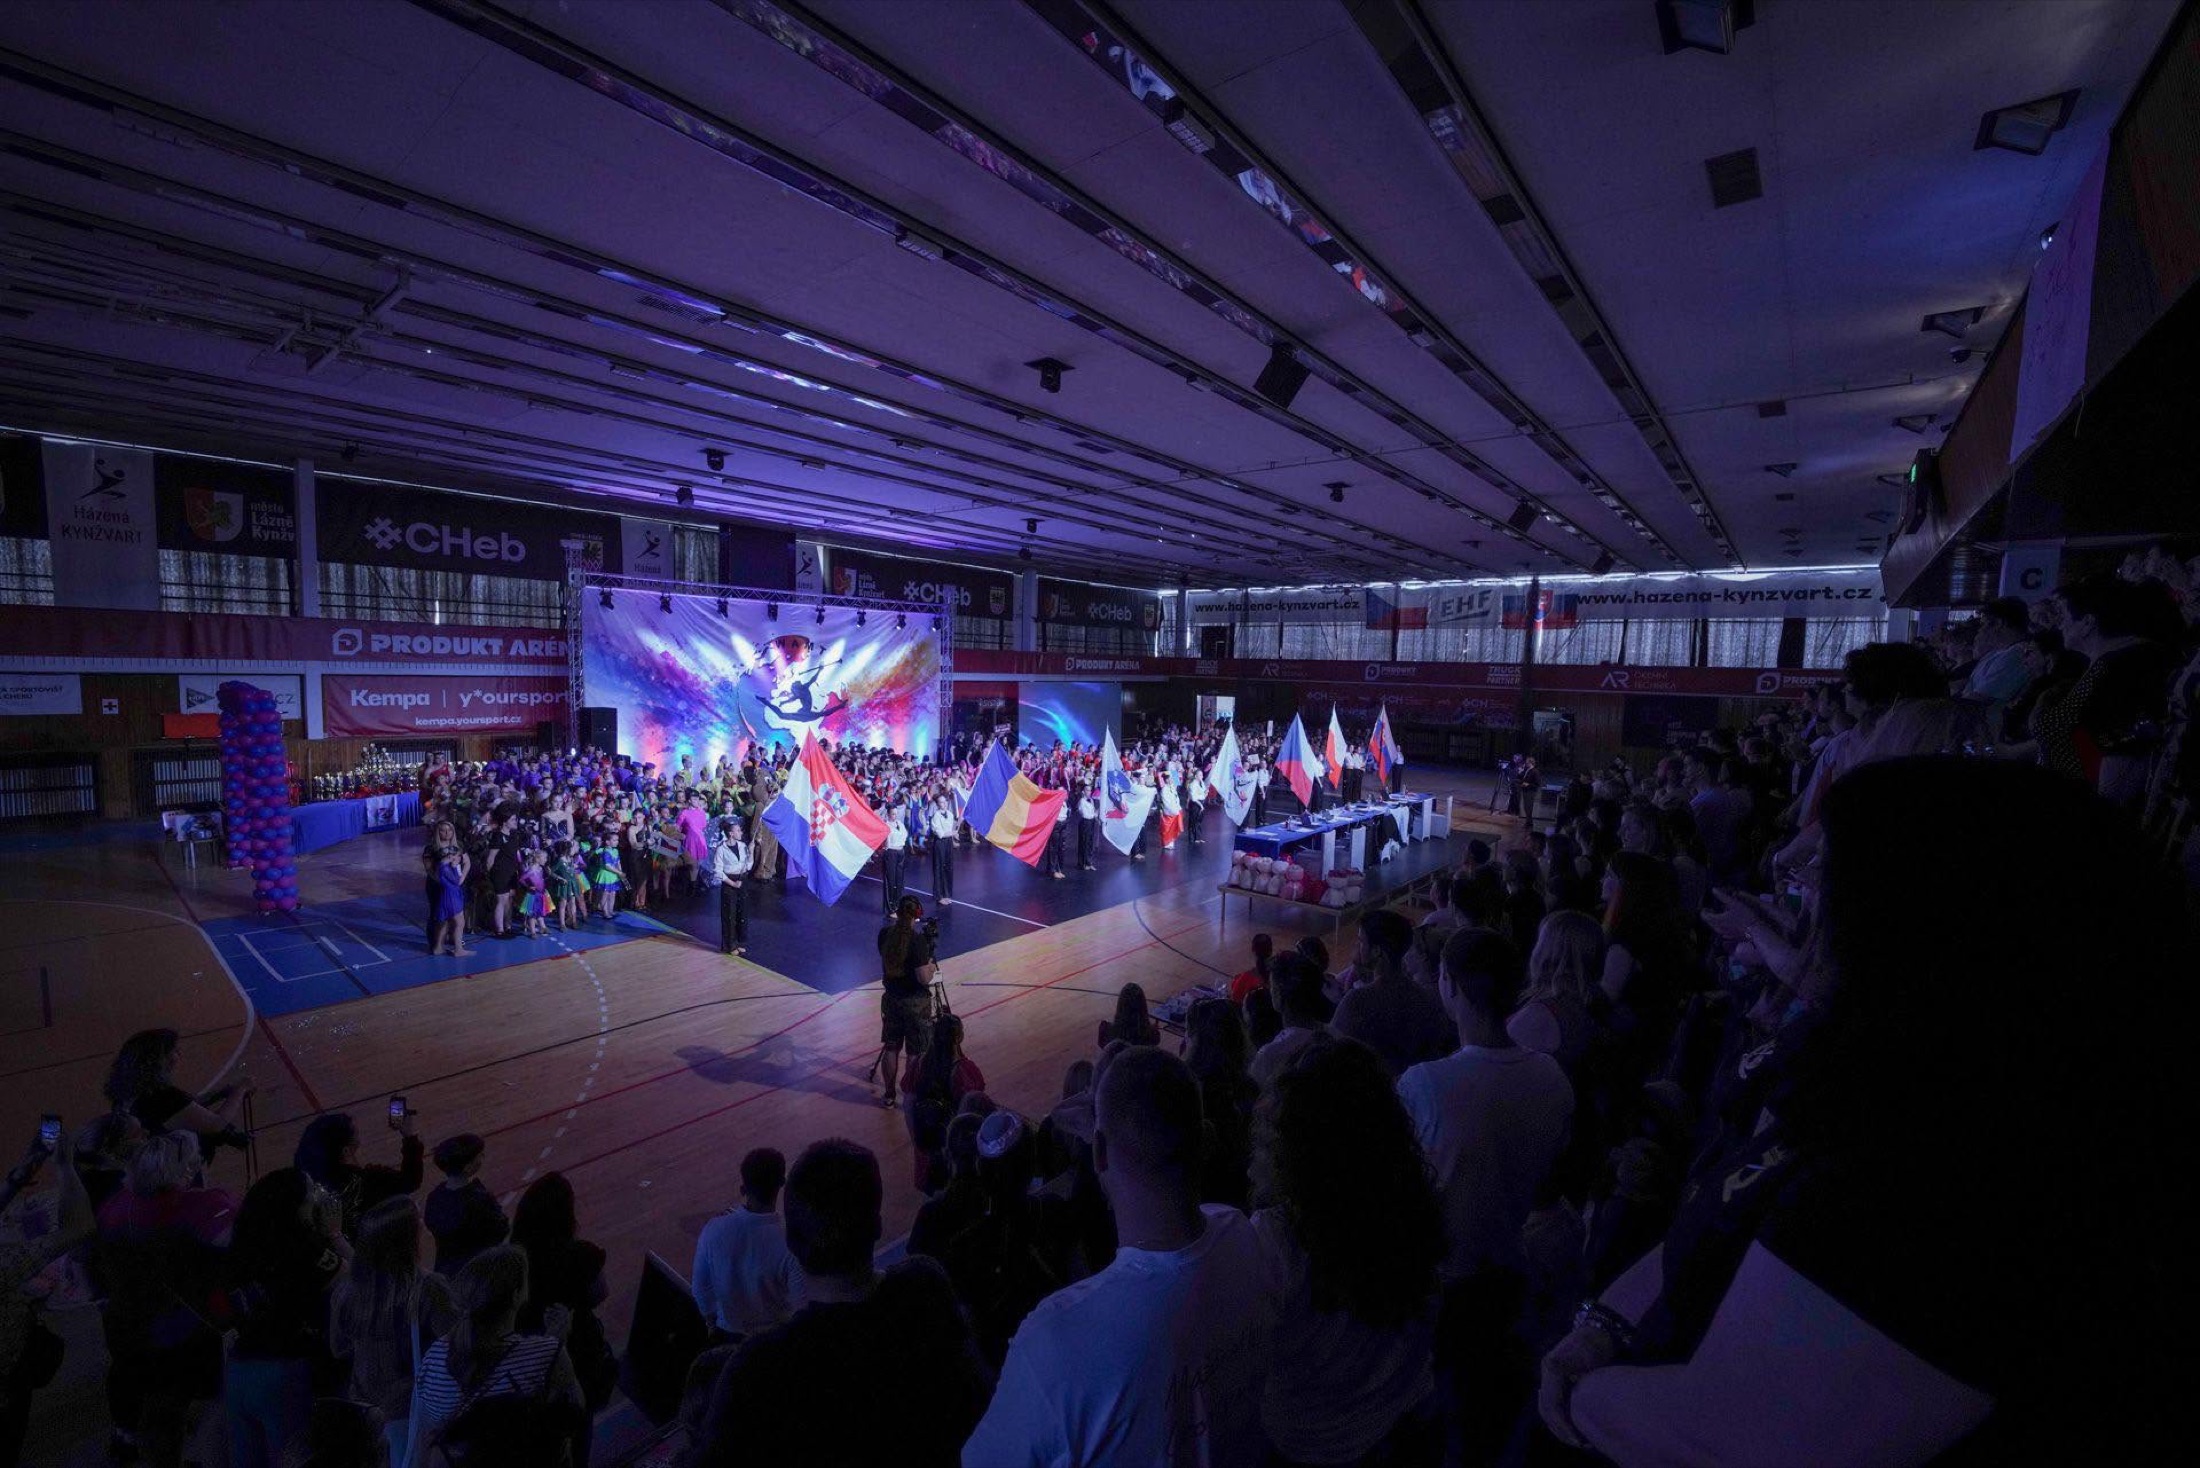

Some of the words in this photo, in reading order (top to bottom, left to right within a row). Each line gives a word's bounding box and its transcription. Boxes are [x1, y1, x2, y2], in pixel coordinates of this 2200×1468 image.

[251, 525, 295, 542] Kynžv
[2020, 568, 2042, 590] C
[1441, 589, 1492, 617] EHF
[1577, 586, 1872, 604] www.hazena-kynzvart.cz
[1195, 600, 1360, 613] www.hazena-kynzvart.cz
[371, 634, 503, 654] PRODUKT
[510, 637, 568, 657] ARÉN
[351, 689, 431, 710] Kempa
[415, 715, 522, 727] kempa.yoursport.cz
